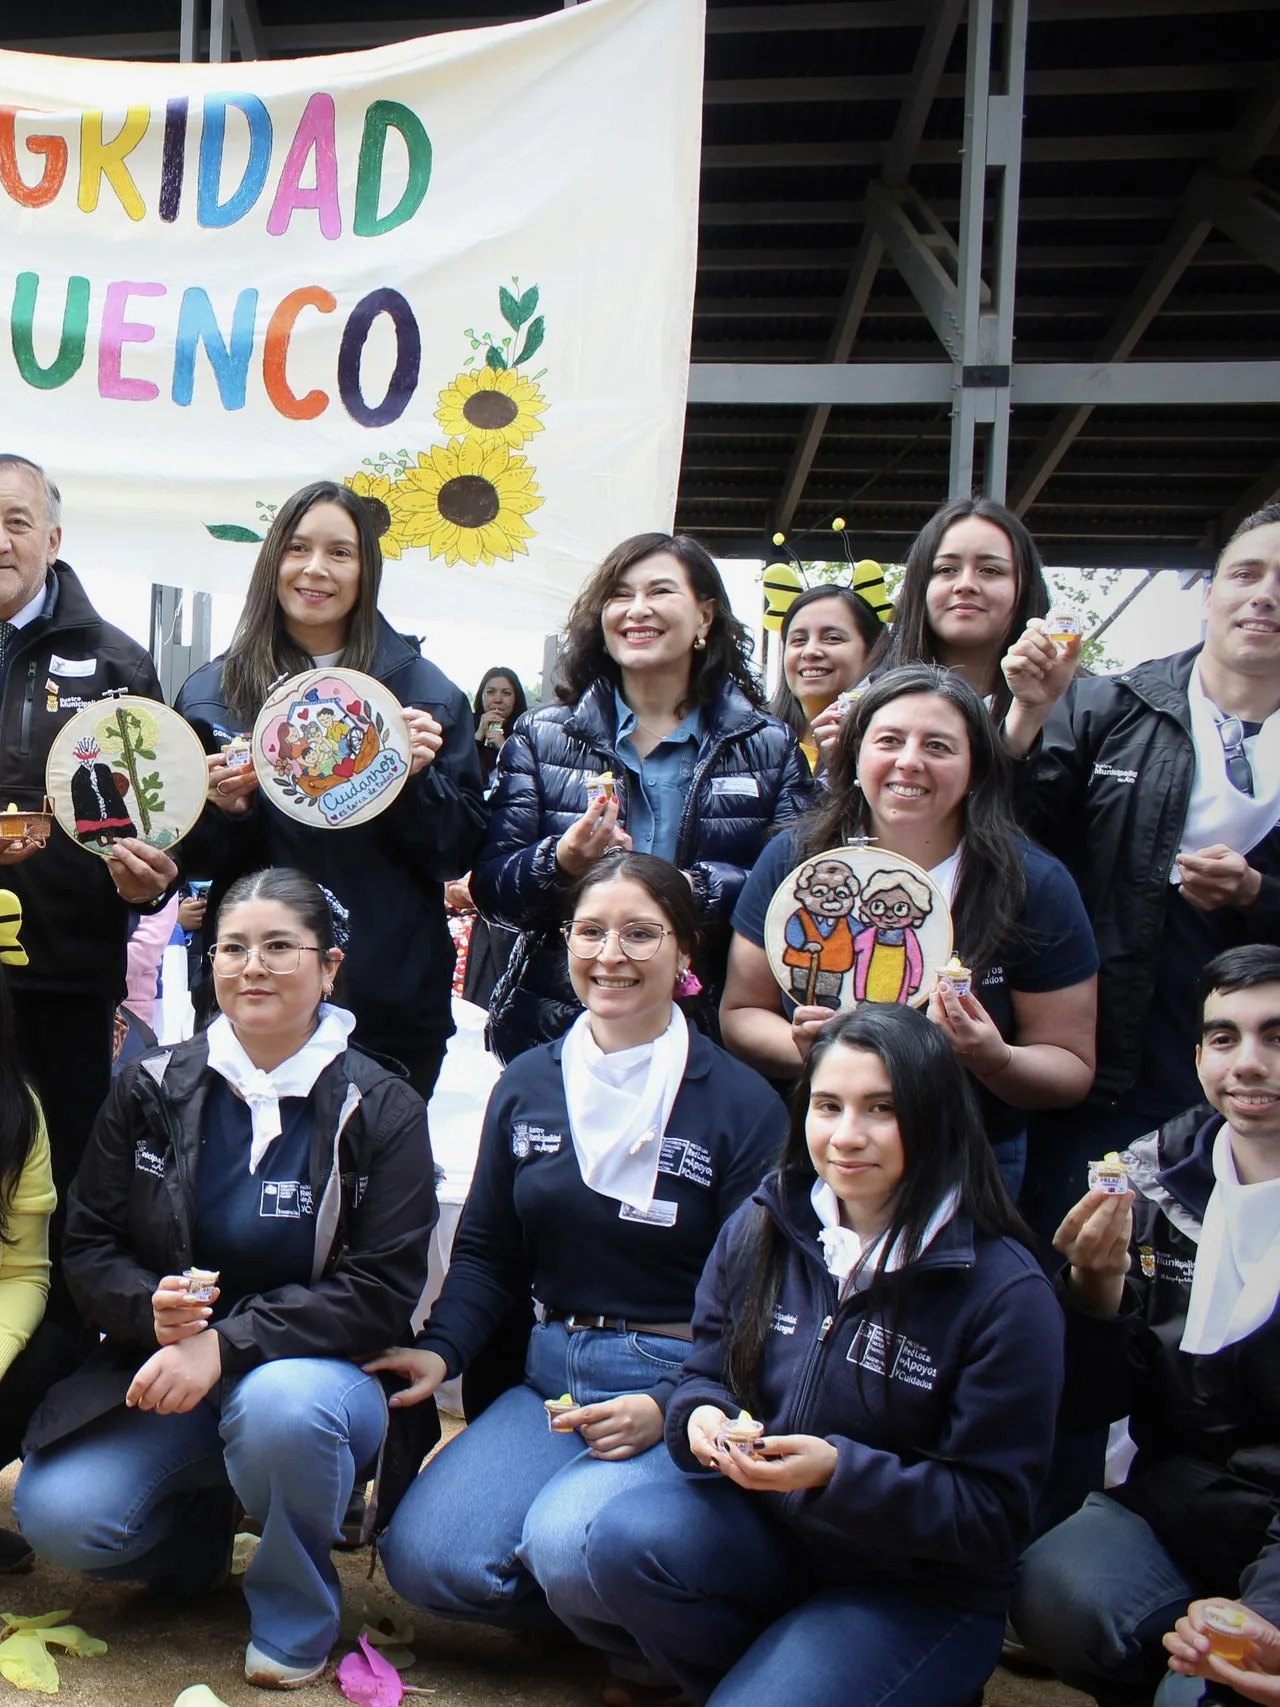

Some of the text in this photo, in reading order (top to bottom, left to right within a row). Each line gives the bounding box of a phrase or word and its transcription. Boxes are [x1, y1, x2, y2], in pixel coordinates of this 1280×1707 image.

[323, 755, 396, 810] Cuidarnos
[339, 808, 348, 817] es
[688, 1158, 713, 1176] Apoyos
[915, 1350, 931, 1363] Local
[903, 1357, 937, 1377] Apoyos
[899, 1371, 933, 1390] Cuidados
